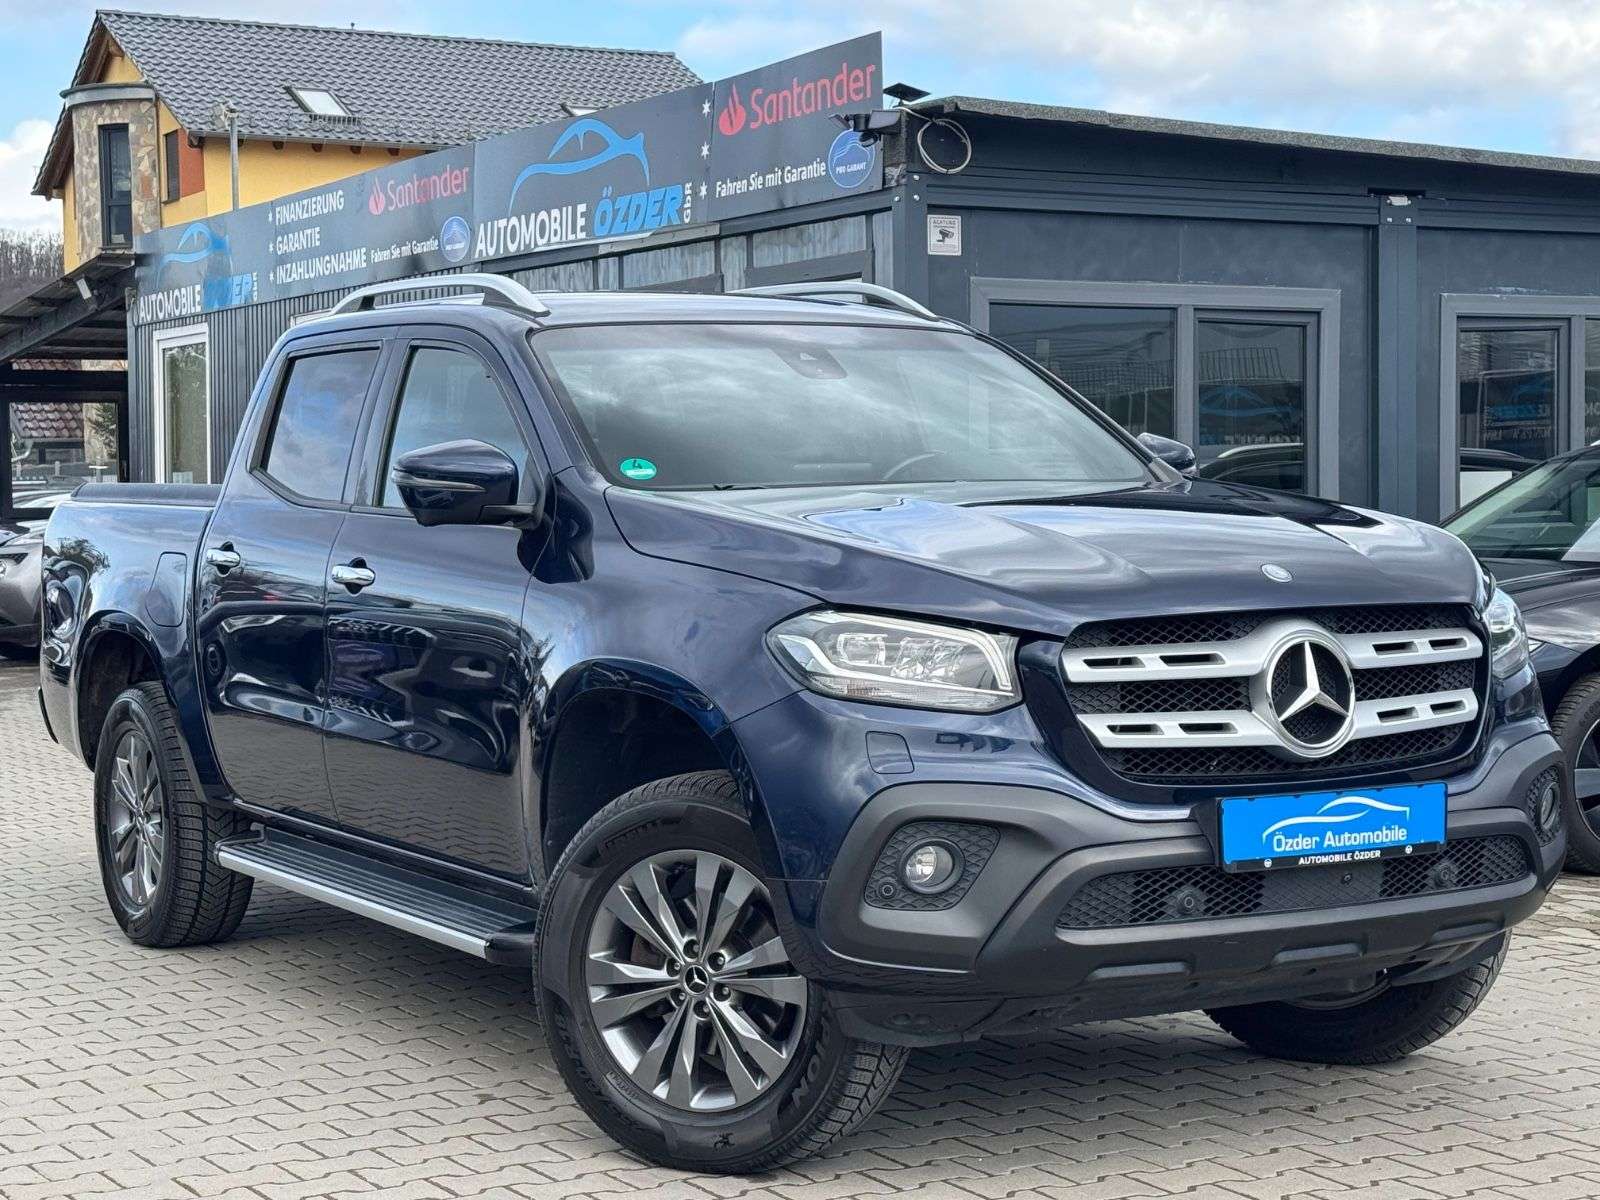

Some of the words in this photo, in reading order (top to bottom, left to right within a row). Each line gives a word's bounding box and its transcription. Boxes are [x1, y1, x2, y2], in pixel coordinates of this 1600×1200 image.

[750, 62, 876, 129] Santander
[387, 164, 469, 211] Santander
[715, 180, 748, 198] Fahren
[749, 174, 764, 191] Sie
[765, 167, 782, 188] mit
[784, 158, 827, 184] Garantie
[275, 190, 344, 225] FINANZIERUNG
[474, 203, 587, 258] AUTOMOBILE
[593, 184, 684, 237] ÖZDER
[683, 182, 693, 224] GbR
[276, 227, 320, 255] GARANTIE
[370, 248, 391, 264] Fahren
[391, 244, 401, 259] Sie
[401, 240, 412, 256] mit
[412, 236, 439, 254] Garantie
[276, 247, 367, 284] INZAHLUNGNAHME
[139, 284, 202, 322] AUTOMOBILE
[1273, 831, 1319, 852] Özder
[1323, 825, 1407, 848] Automobile
[1298, 852, 1353, 865] AUTOMOBILE
[1354, 849, 1381, 861] ÖZDER
